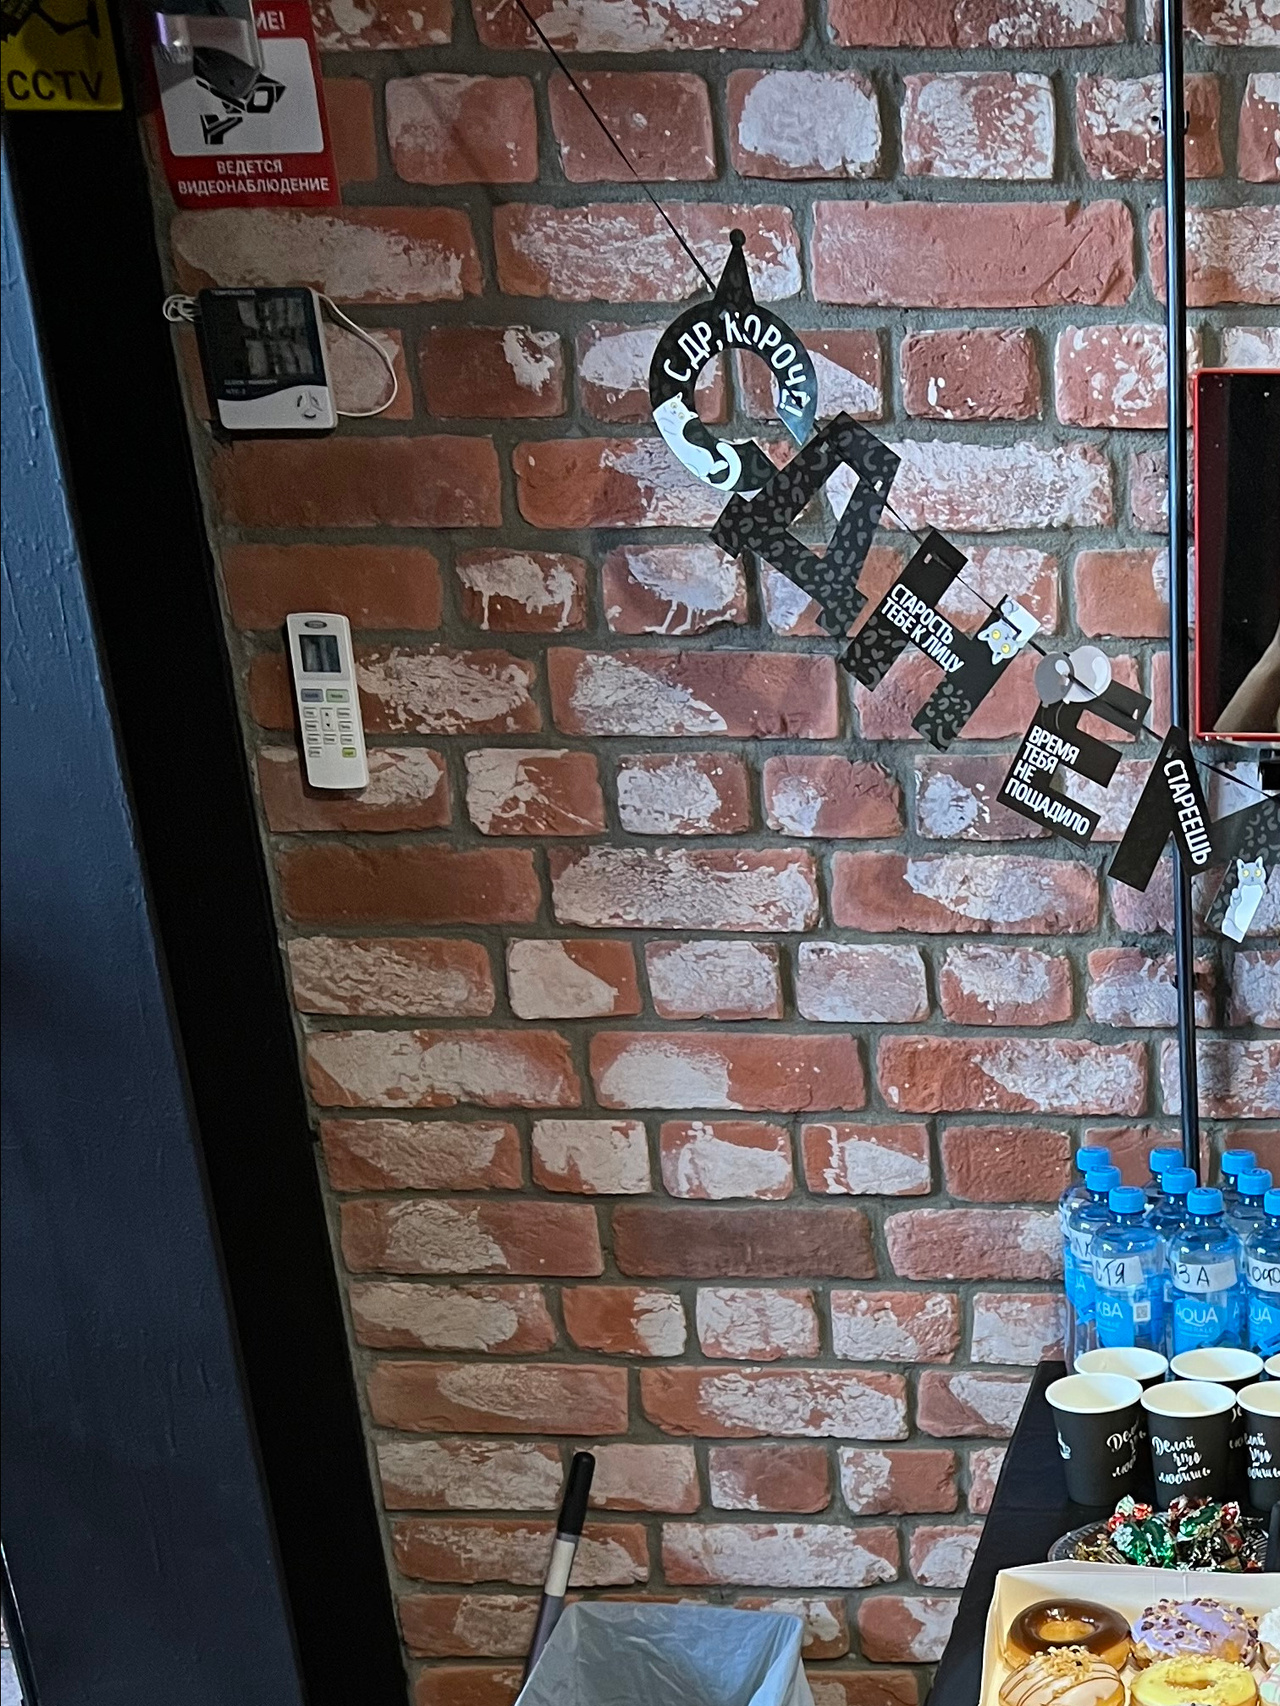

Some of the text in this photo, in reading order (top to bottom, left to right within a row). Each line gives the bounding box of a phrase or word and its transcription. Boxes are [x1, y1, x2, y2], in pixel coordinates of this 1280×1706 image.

[7, 69, 103, 101] CCTV
[216, 159, 283, 177] ВЕДЕТСЯ
[178, 177, 330, 197] ВИДЕОНАБЛЮДЕНИЕ
[663, 358, 692, 382] С
[891, 583, 954, 645] СТАРОСТЬ
[881, 597, 965, 673] ТЕБЕ К ЛИЦУ
[1023, 742, 1059, 774] ТЕБЯ
[1028, 725, 1080, 765] ВРЕМЯ
[1013, 760, 1037, 784] НЕ
[1004, 778, 1090, 836] ПОЩАДИЛО
[1163, 759, 1213, 865] СТАРЕЕШЬ
